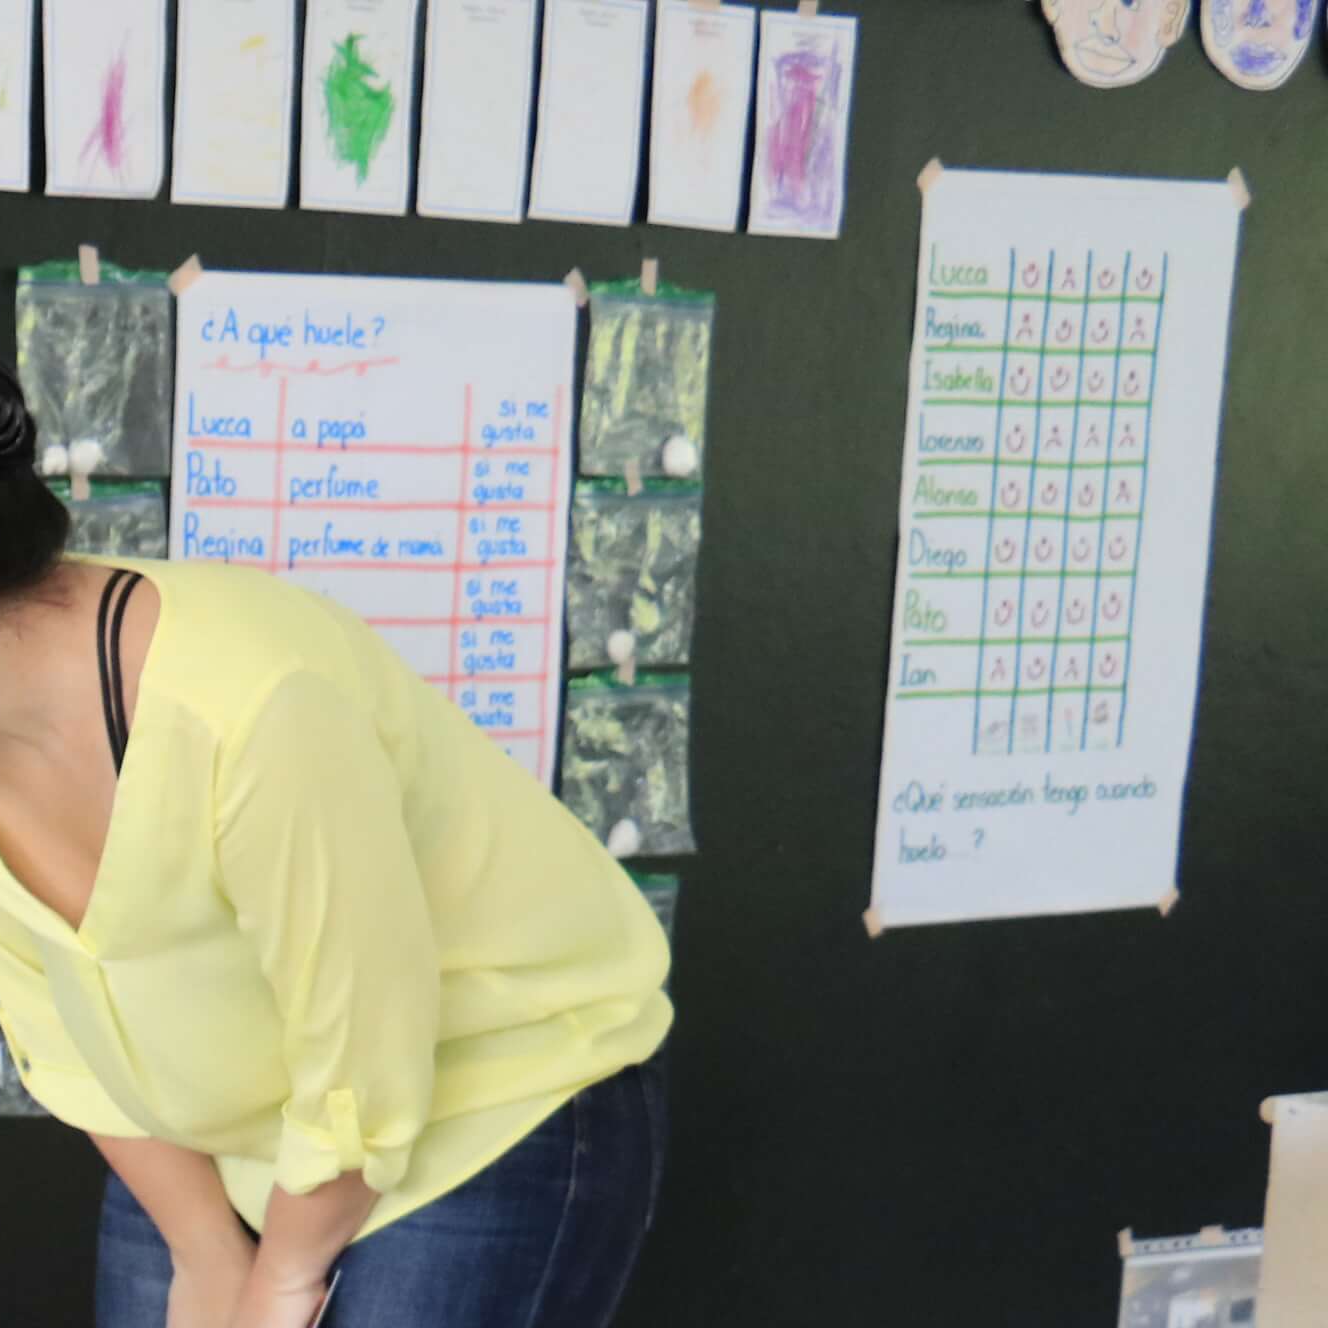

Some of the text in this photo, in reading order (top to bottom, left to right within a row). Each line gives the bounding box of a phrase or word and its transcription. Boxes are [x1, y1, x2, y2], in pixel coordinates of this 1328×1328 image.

[928, 243, 989, 286] Lucca
[922, 360, 993, 393] Isabella
[187, 391, 252, 438] Lucca
[290, 416, 307, 438] a
[917, 412, 985, 454] Lorenzo
[480, 420, 535, 449] gusta
[185, 450, 380, 504] Pato perfume
[472, 480, 525, 506] gusta
[912, 474, 979, 507] Alonso
[182, 511, 264, 562] Regina
[288, 521, 364, 570] perfume
[371, 531, 389, 555] de
[476, 535, 527, 564] gusta
[907, 528, 969, 574] Diego
[471, 597, 523, 621] gusta
[902, 588, 948, 634] Pato
[462, 648, 516, 675] gusta
[899, 654, 938, 687] Ian
[1044, 771, 1090, 816] tengo
[1095, 775, 1158, 800] cuando
